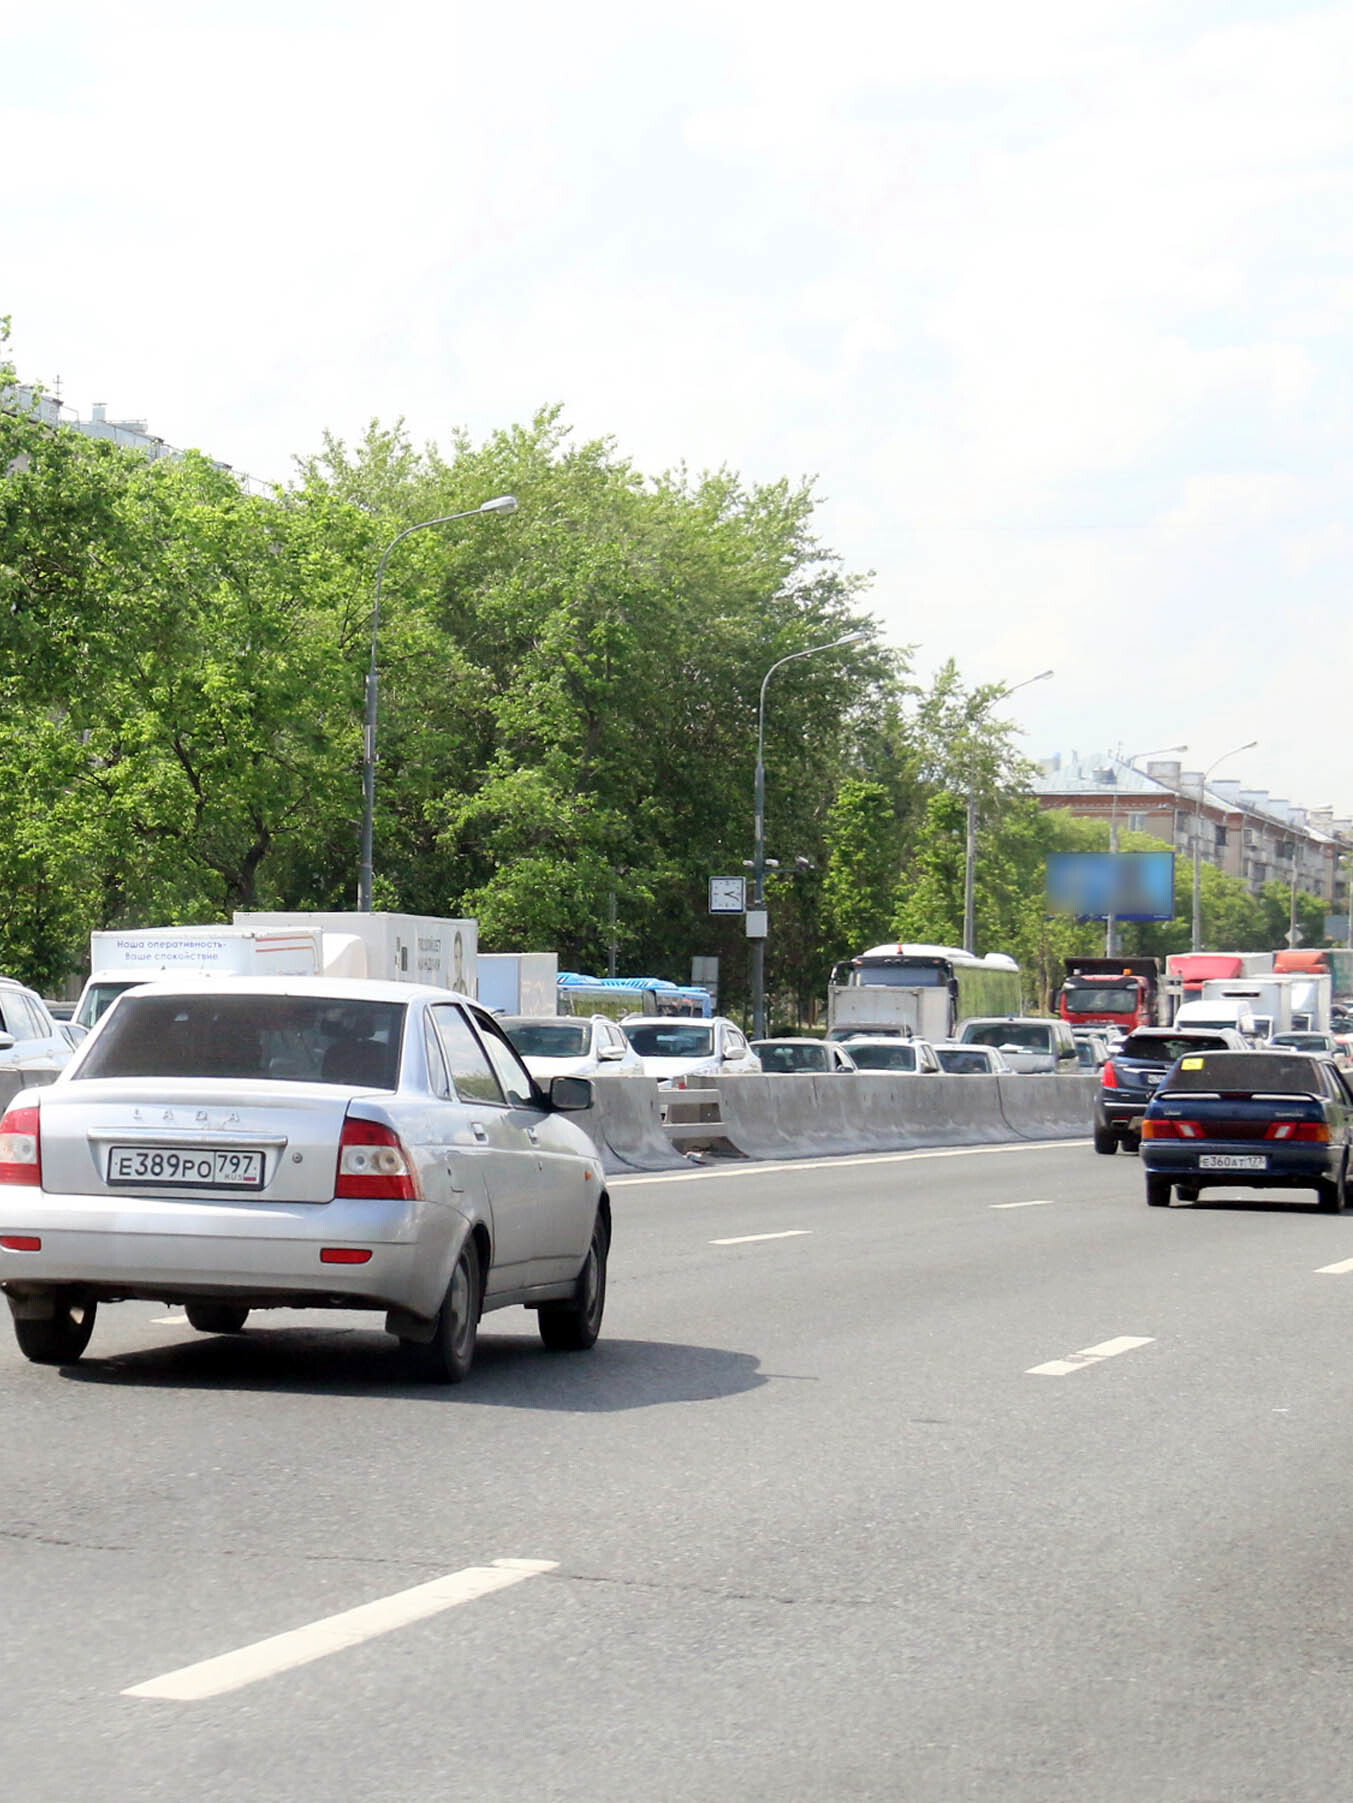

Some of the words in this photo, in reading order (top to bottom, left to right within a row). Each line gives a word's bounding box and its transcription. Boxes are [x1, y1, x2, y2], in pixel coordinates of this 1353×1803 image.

[117, 940, 145, 949] Наша
[125, 952, 152, 961] Ваше
[154, 951, 219, 961] спокойствие
[217, 1154, 254, 1174] 797
